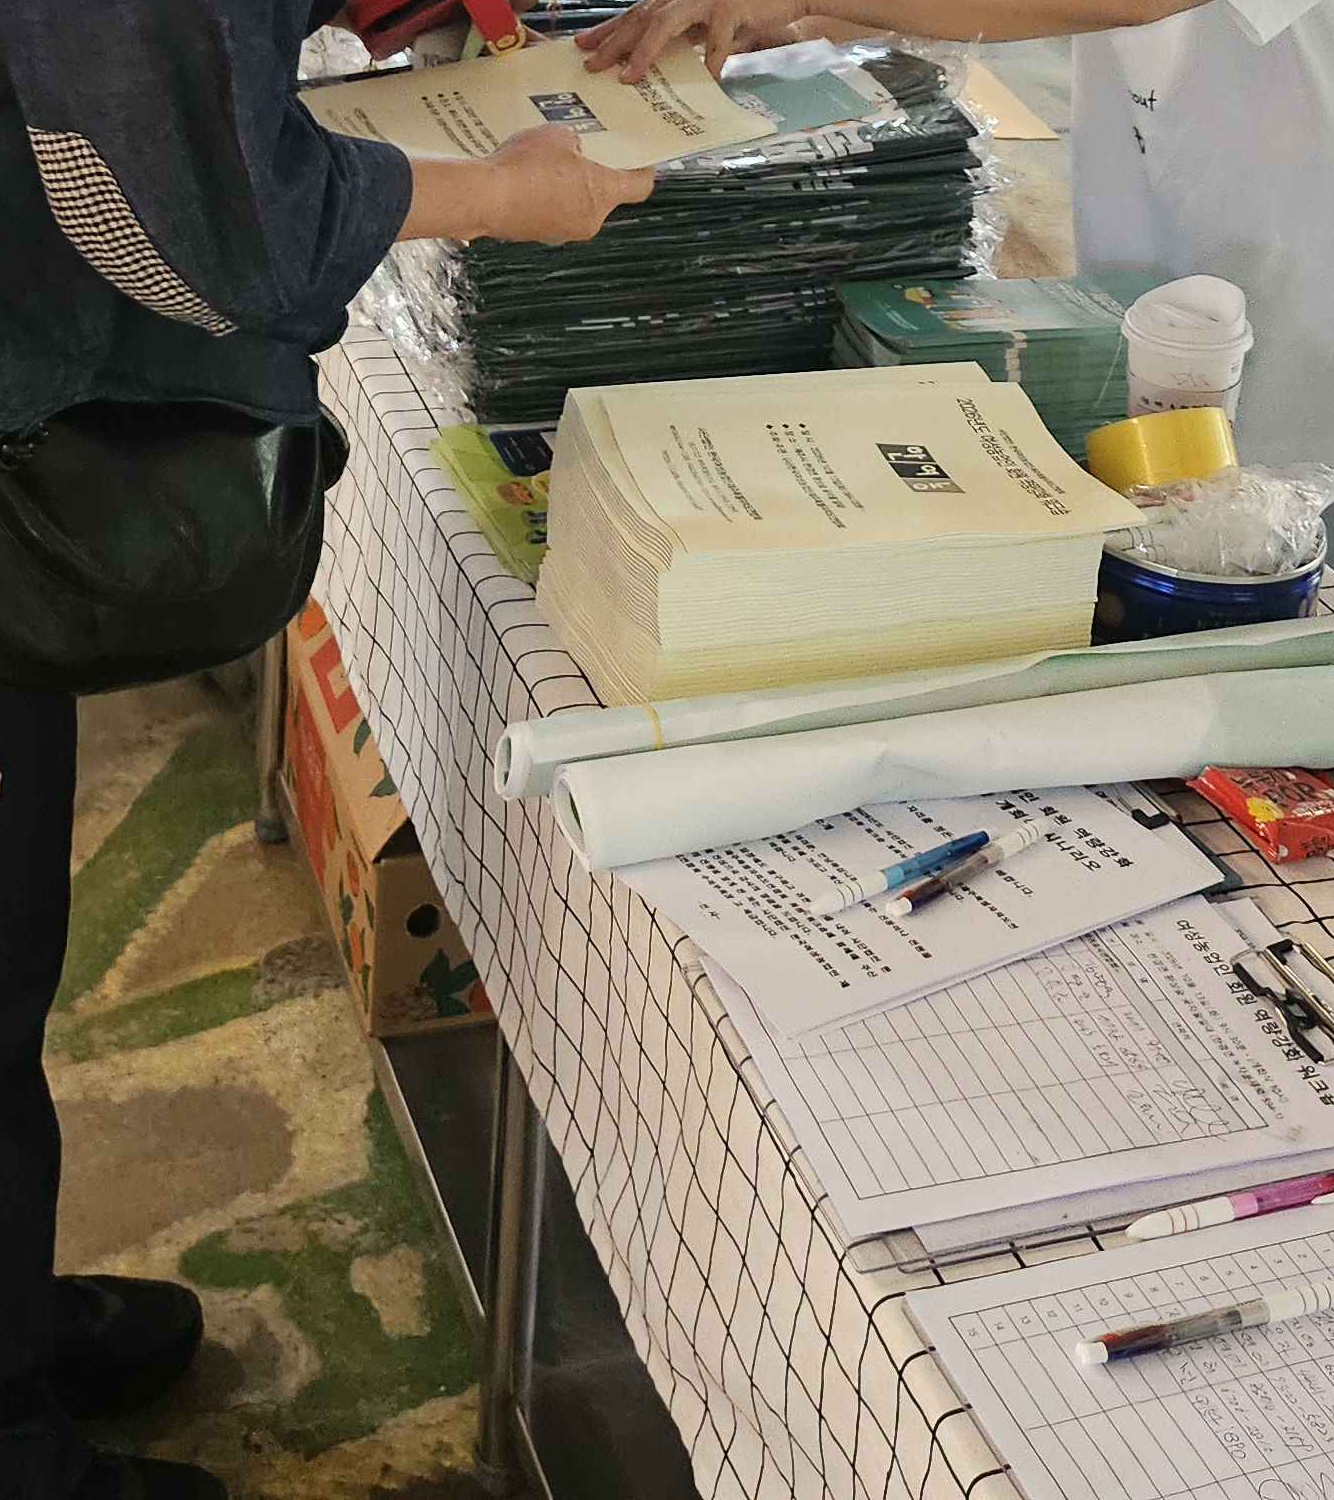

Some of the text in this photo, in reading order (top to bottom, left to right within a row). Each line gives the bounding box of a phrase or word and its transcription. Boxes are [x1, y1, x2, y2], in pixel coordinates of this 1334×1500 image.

[953, 398, 993, 433] 2026년도
[974, 435, 1018, 467] 여성농업인
[1039, 831, 1104, 872] 시나리오
[1068, 827, 1136, 869] 역량강화
[1169, 919, 1236, 976] 여성농업인
[1221, 980, 1261, 1005] 회원
[1246, 1009, 1307, 1061] 역량강화
